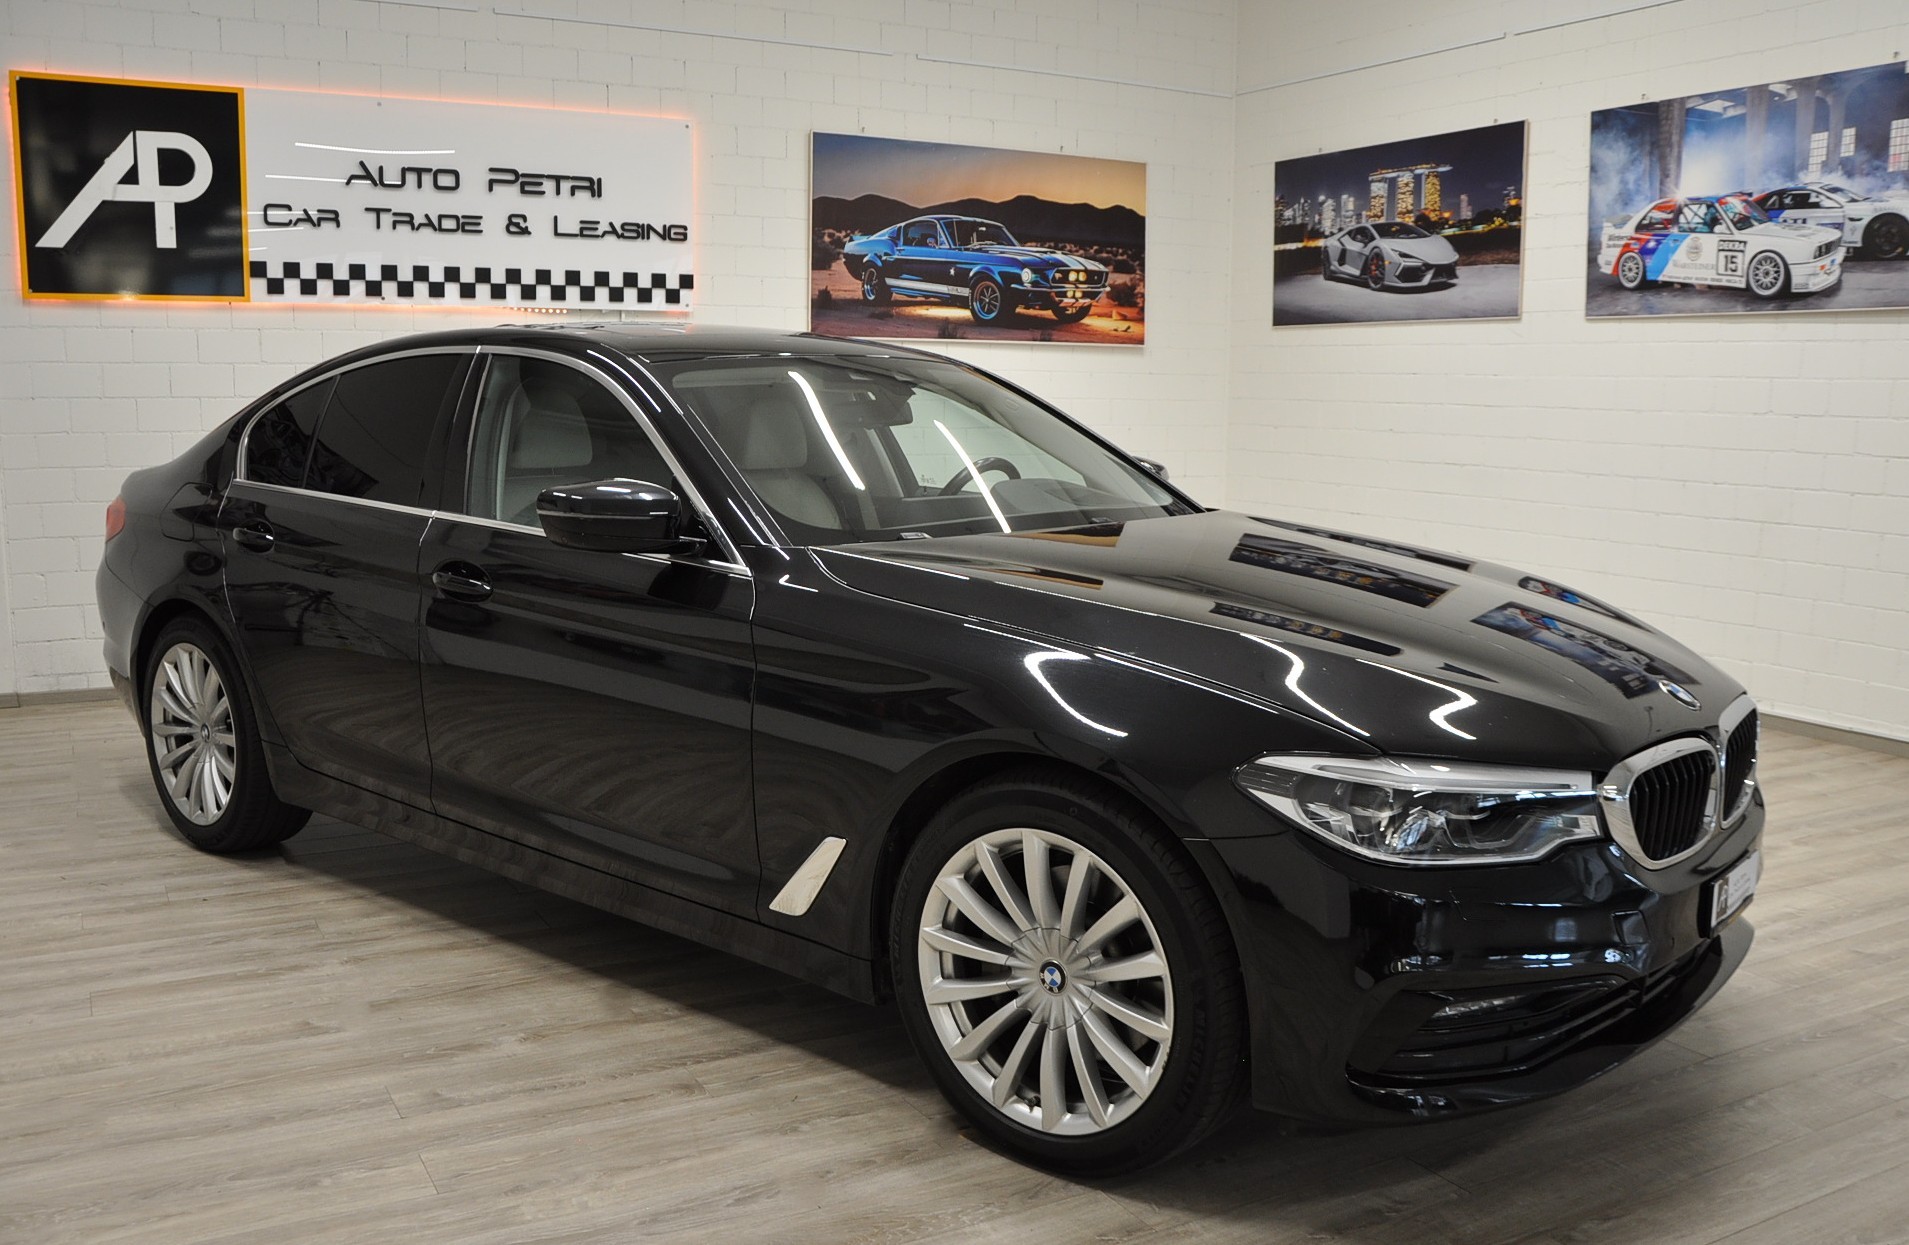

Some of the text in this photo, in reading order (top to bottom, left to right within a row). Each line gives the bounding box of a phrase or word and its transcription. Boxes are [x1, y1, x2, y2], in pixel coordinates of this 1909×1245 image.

[35, 130, 213, 249] AP
[505, 213, 532, 236] &
[1723, 255, 1738, 272] 15
